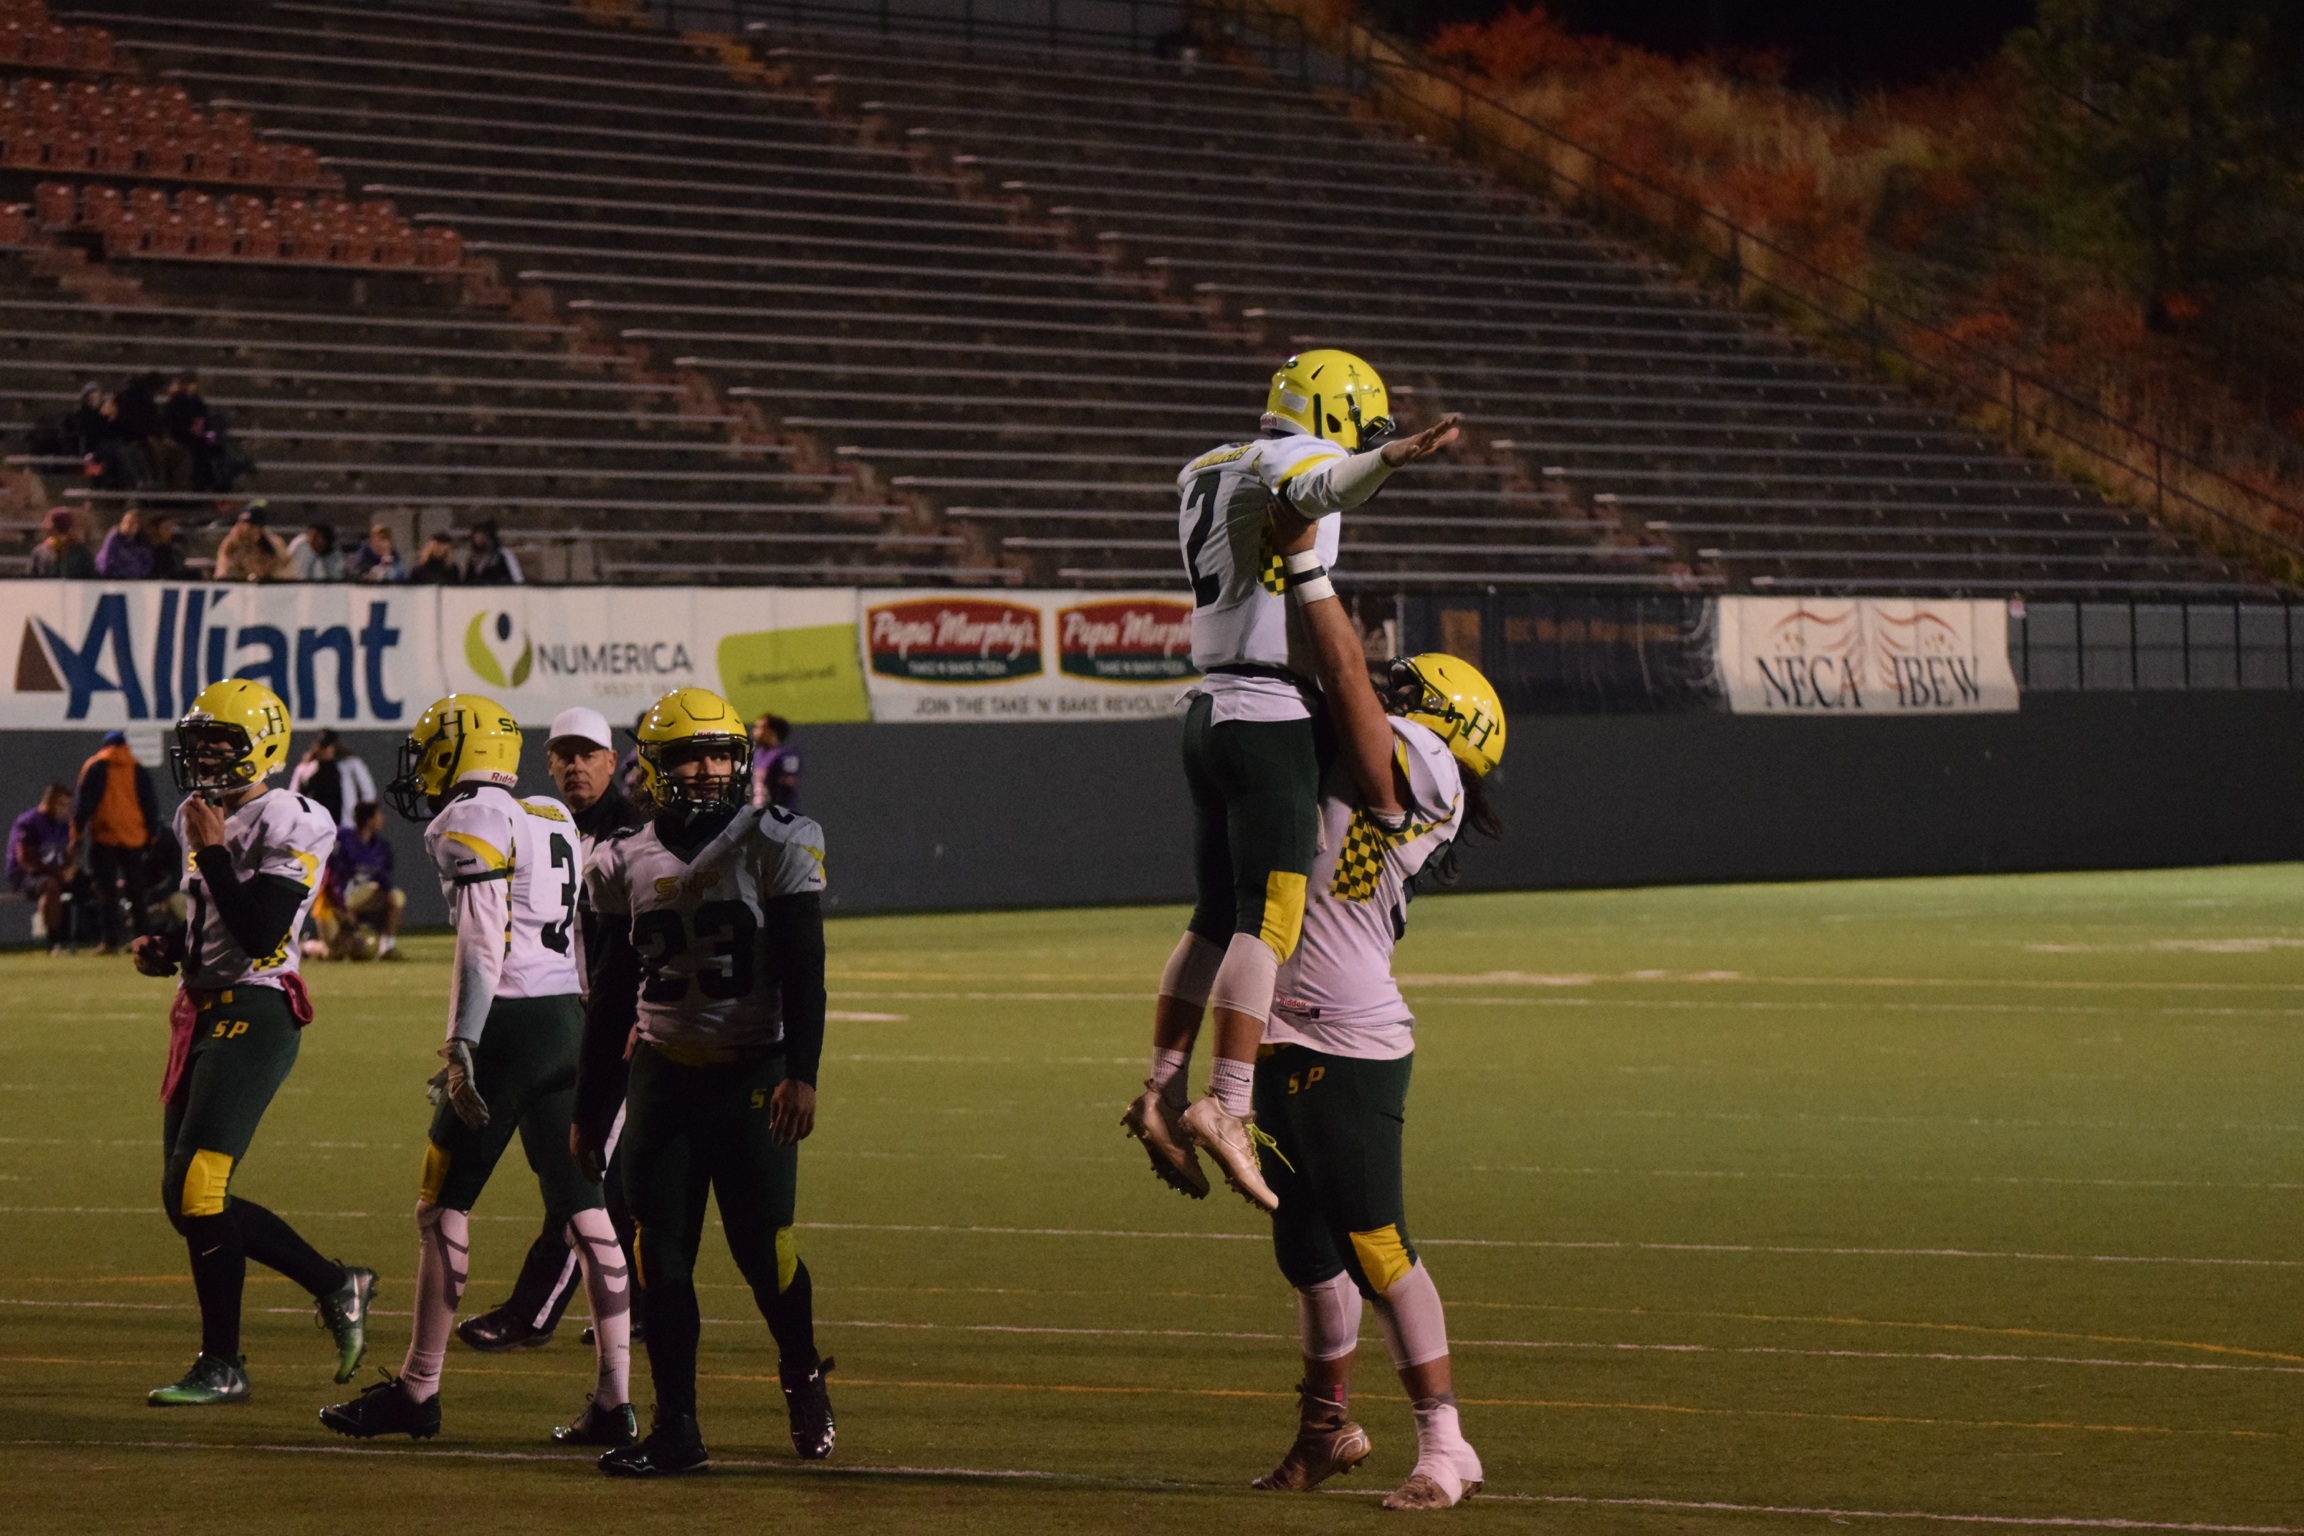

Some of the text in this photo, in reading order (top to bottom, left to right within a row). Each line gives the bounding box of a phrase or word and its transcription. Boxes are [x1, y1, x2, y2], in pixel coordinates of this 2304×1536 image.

[1186, 472, 1221, 609] 2
[34, 589, 406, 720] Alliant
[873, 609, 1037, 661] Papa Murphy's
[1062, 611, 1119, 660] Papa
[538, 644, 693, 675] NUMERICA
[1756, 656, 1980, 708] NECA IBEW
[262, 705, 286, 736] H
[438, 710, 467, 740] H
[913, 696, 950, 713] JOIN
[955, 696, 983, 713] THE
[990, 696, 1029, 713] TAKE
[1057, 696, 1098, 713] BAKE
[1459, 708, 1495, 751] H
[541, 832, 577, 958] 3
[631, 900, 755, 1002] 23
[212, 1020, 250, 1039] SP
[1288, 1066, 1325, 1094] SP
